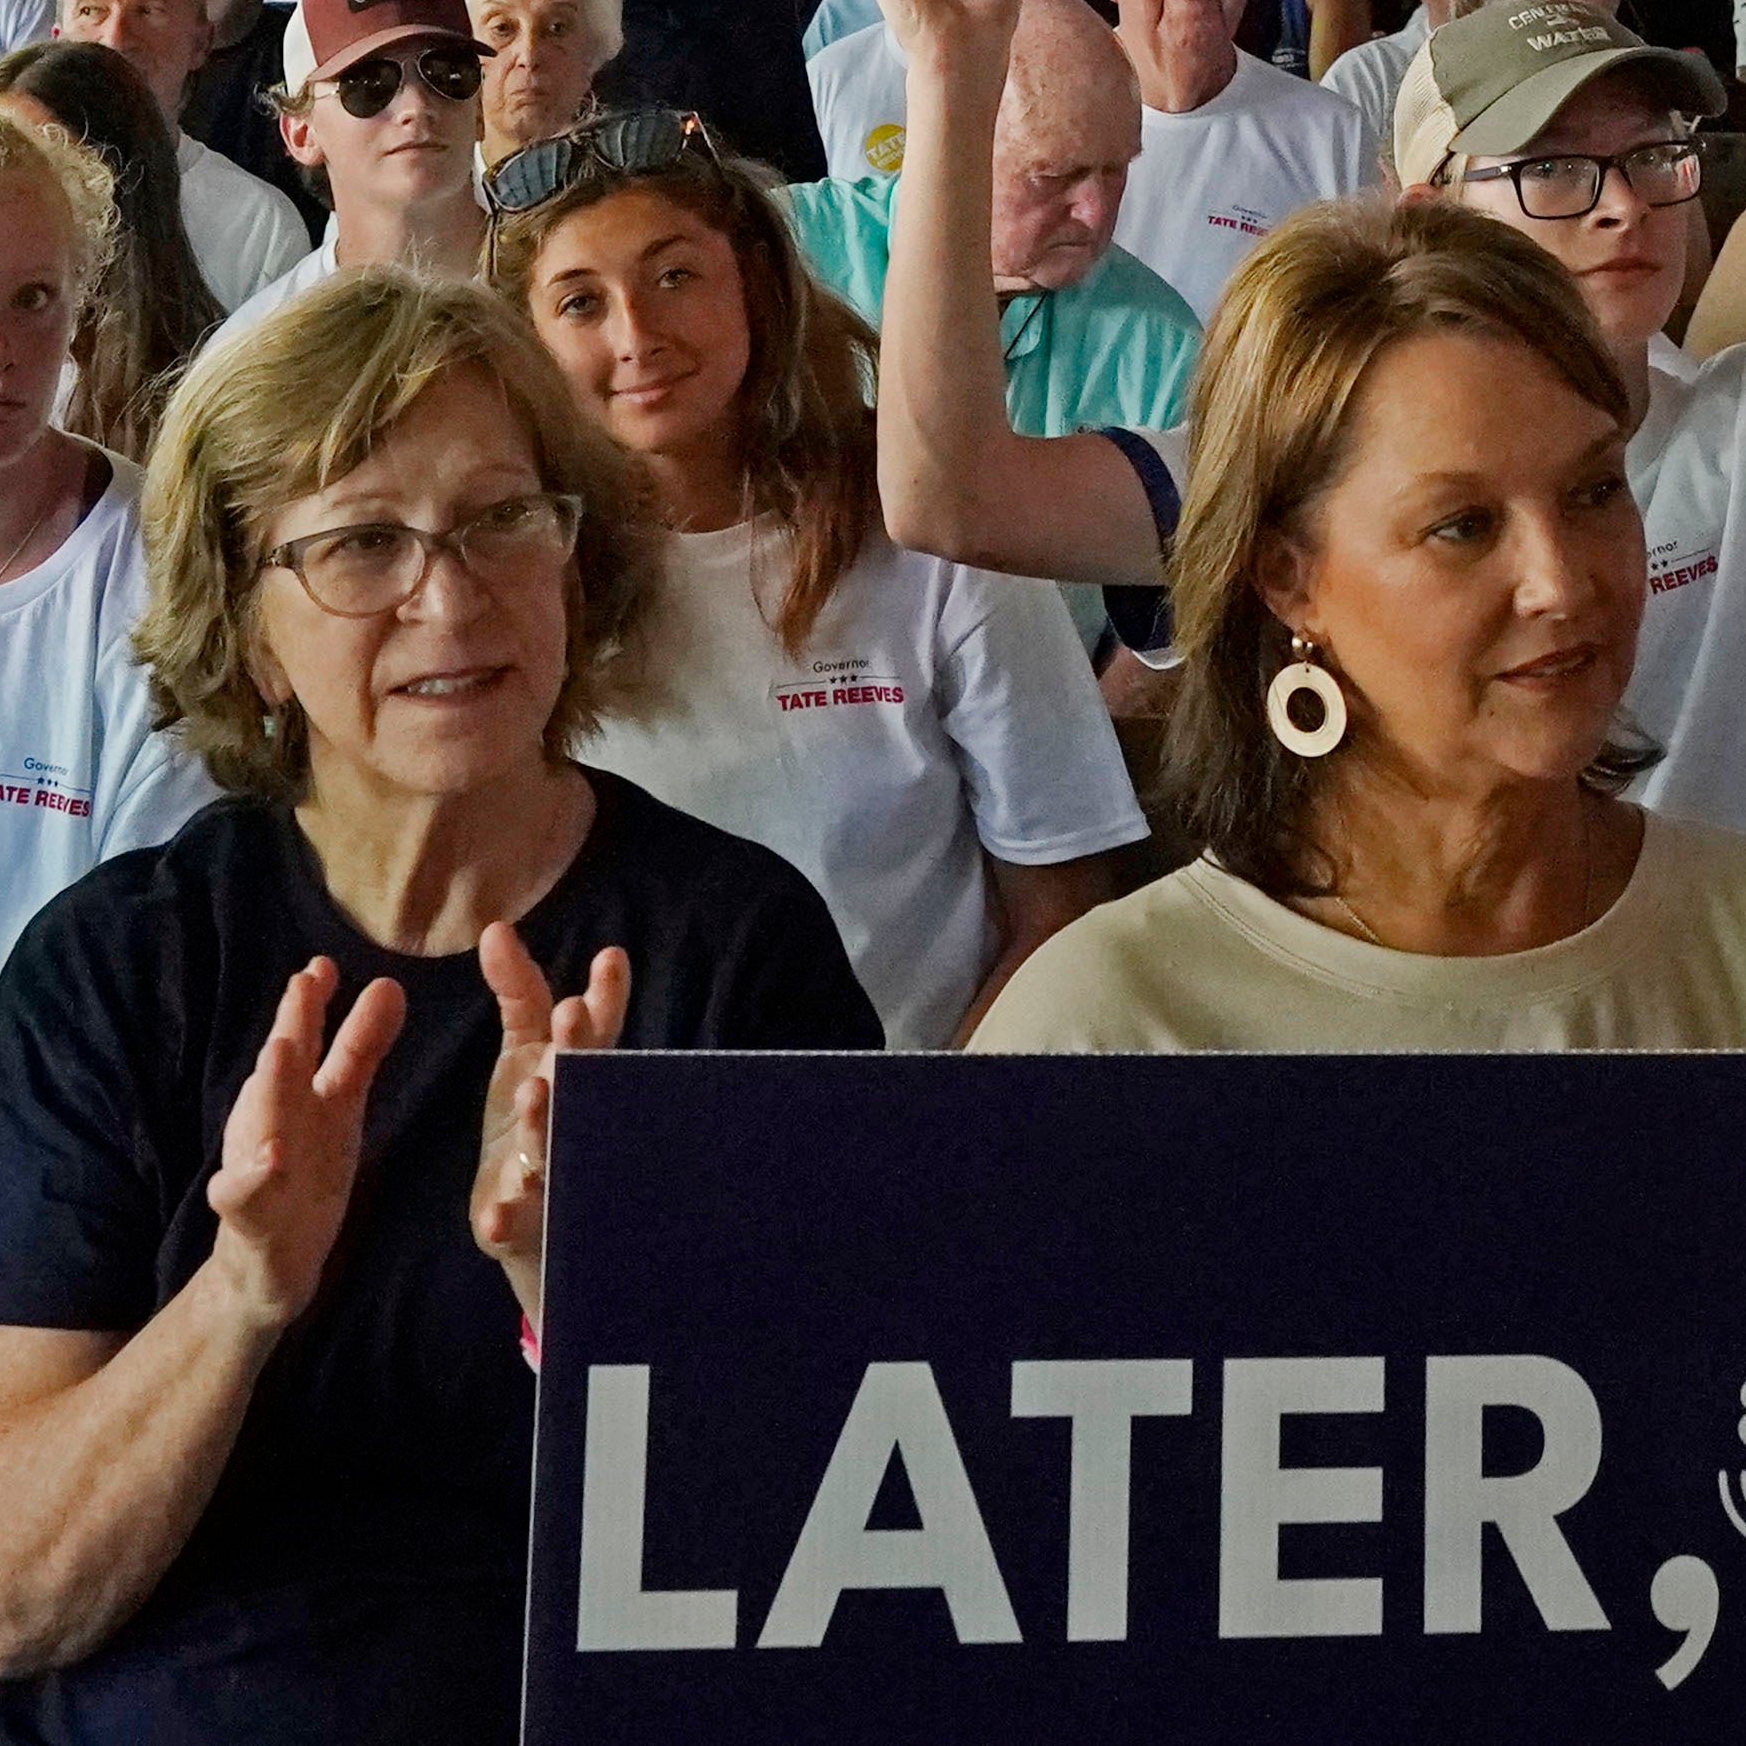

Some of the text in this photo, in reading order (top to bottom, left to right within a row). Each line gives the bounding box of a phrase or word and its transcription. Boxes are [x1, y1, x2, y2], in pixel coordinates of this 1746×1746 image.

[1649, 555, 1719, 595] REEVES
[813, 660, 869, 673] Governor
[776, 685, 904, 711] TATE REEVES
[35, 790, 91, 817] REEVES
[575, 1353, 1721, 1692] LATER,
